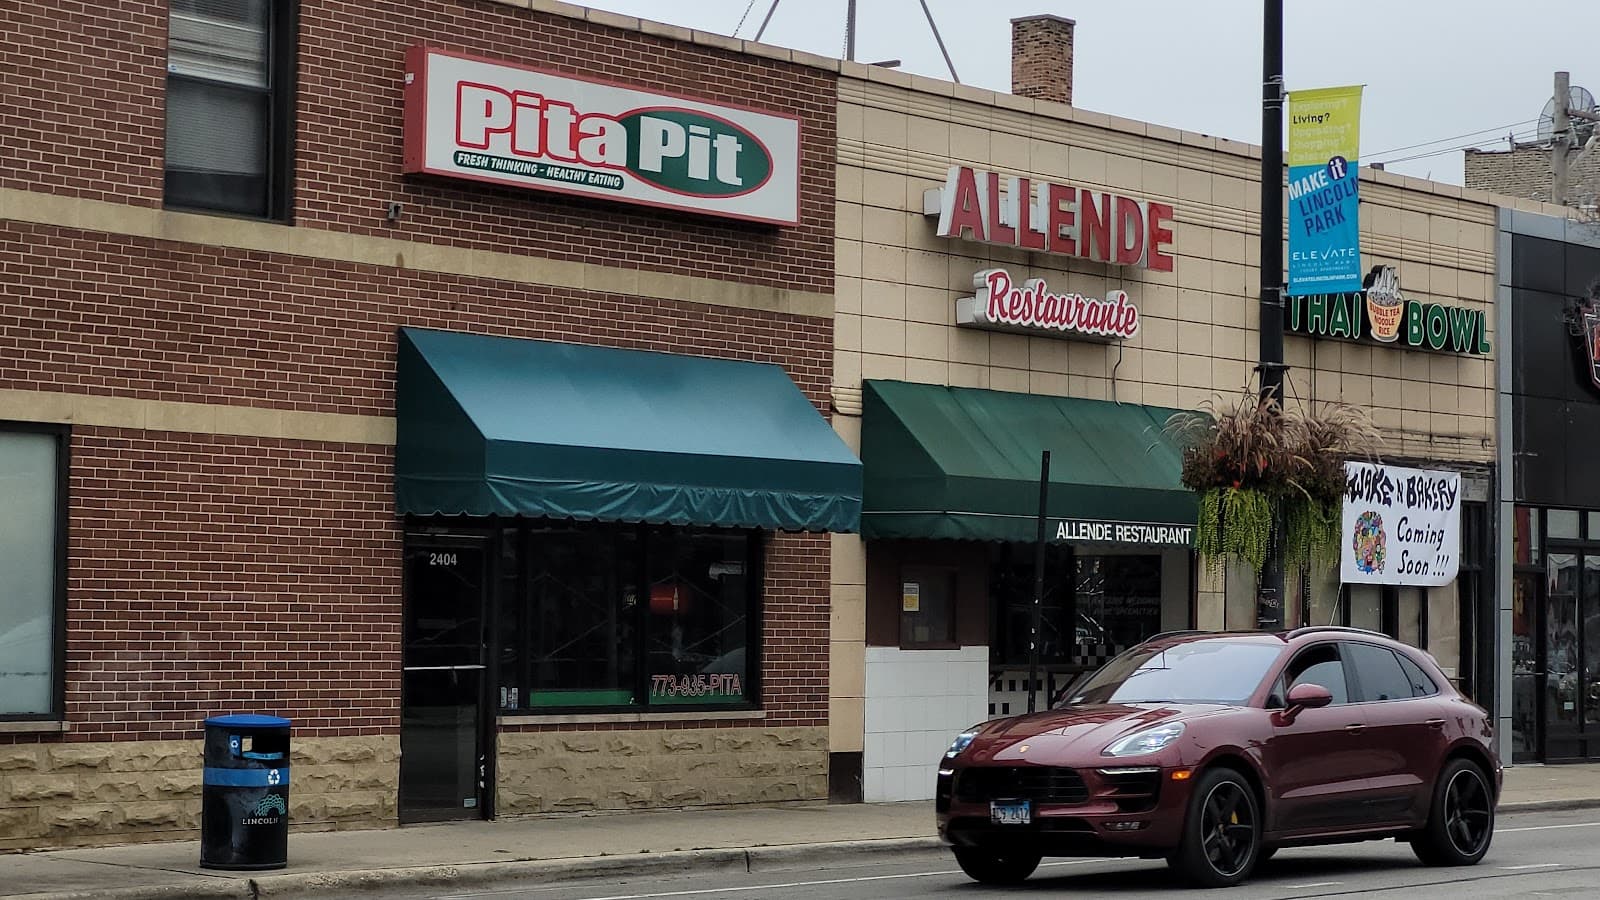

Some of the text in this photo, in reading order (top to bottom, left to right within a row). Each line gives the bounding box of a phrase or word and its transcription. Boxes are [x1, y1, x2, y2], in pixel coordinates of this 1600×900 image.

[456, 81, 743, 186] Pita Pit
[1293, 112, 1330, 124] Living?
[457, 152, 488, 167] FRESH
[491, 157, 538, 175] THINKING
[547, 166, 587, 182] HEALTHY
[588, 172, 621, 187] EATING
[1289, 158, 1345, 200] MAKE it
[1299, 176, 1358, 216] LINCOLN
[938, 166, 1173, 272] ALLENDE
[1304, 204, 1346, 237] PARK
[1293, 244, 1356, 260] ELEVATE
[986, 271, 1138, 337] Restaurante
[1369, 302, 1400, 317] BUBBLE TEA
[1374, 315, 1395, 326] NOODLE
[1291, 292, 1491, 355] THAI BOWL
[1378, 327, 1391, 335] RICE
[1406, 475, 1458, 511] BAKERY
[1056, 521, 1192, 544] ALLENDE RESTAURANT
[1397, 516, 1445, 551] Coming
[429, 553, 458, 566] 2404
[1397, 549, 1429, 575] Soon
[651, 674, 743, 697] 773-935-PITA
